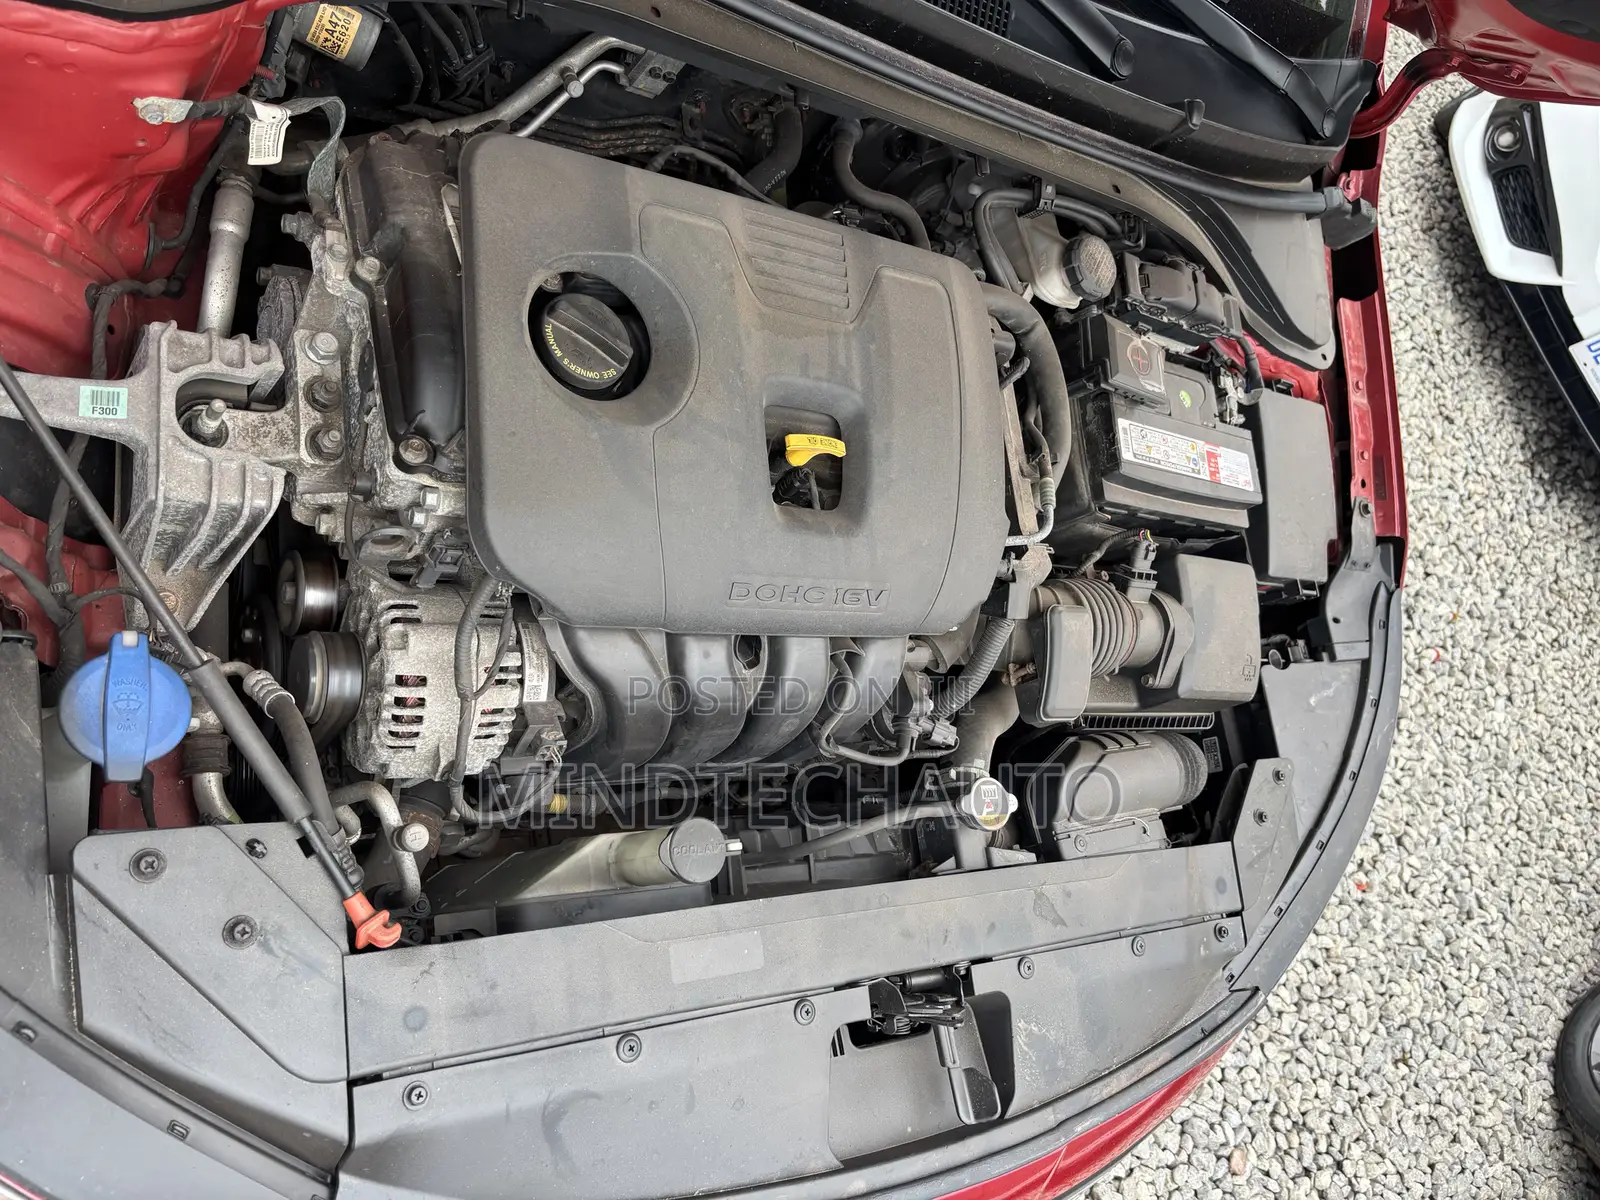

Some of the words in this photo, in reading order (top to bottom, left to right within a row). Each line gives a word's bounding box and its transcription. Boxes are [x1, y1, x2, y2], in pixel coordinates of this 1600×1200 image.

[324, 10, 342, 39] A47
[335, 18, 351, 44] E620
[544, 323, 563, 358] MANUAL
[562, 357, 600, 380] OWNER'S
[602, 368, 617, 380] SEE
[91, 406, 118, 416] F300
[728, 581, 827, 604] DOHC
[833, 587, 888, 607] 16V
[672, 842, 725, 857] COOLANT
